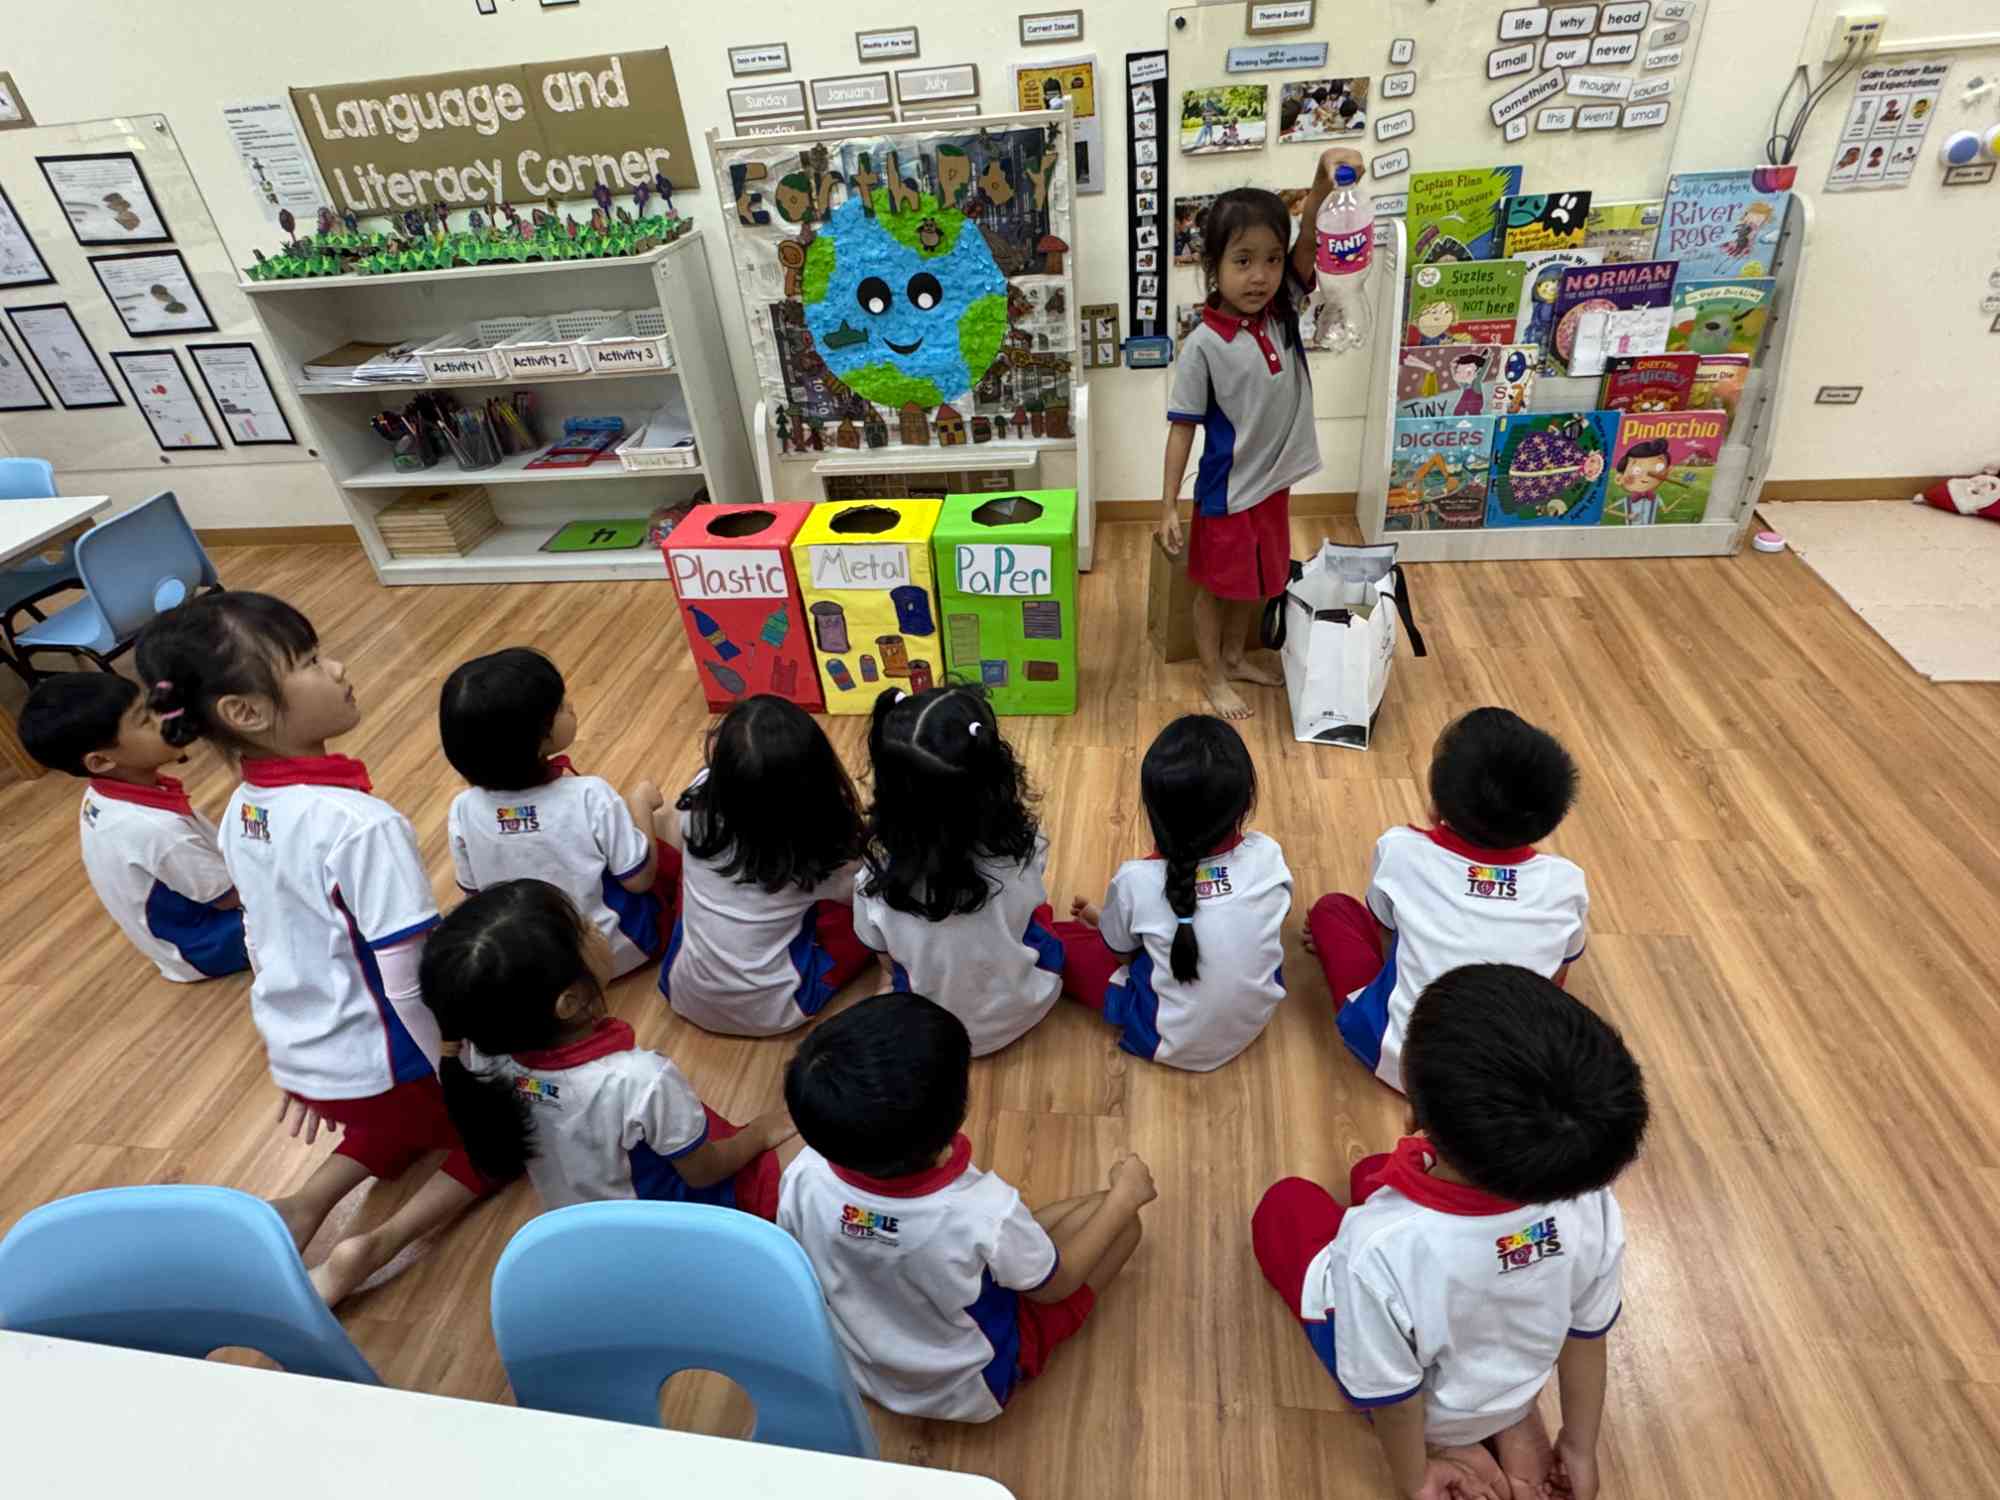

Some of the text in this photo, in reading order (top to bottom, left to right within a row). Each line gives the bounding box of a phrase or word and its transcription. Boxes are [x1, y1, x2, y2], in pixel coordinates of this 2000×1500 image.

[1260, 12, 1281, 20] Theme
[1559, 15, 1586, 30] why
[1607, 11, 1640, 26] head
[1027, 22, 1075, 33] Current Issues
[1514, 18, 1533, 31] life
[1556, 49, 1577, 60] our
[1596, 44, 1633, 57] never
[1496, 53, 1528, 70] small
[1861, 64, 1948, 80] Calm Corner Rules
[925, 77, 949, 91] July
[1390, 79, 1408, 93] big
[1578, 79, 1621, 93] thought
[1633, 80, 1669, 98] sound
[1860, 77, 1940, 92] and Expectations
[308, 82, 527, 144] Language
[541, 56, 629, 114] and
[827, 86, 876, 101] January
[1498, 76, 1558, 118] something
[745, 94, 788, 110] Sunday
[1546, 110, 1566, 124] this
[1583, 110, 1614, 122] went
[1631, 106, 1661, 121] small
[1382, 118, 1407, 134] then
[1379, 157, 1402, 172] very
[334, 156, 503, 211] Literacy
[516, 146, 671, 197] Corner
[1413, 175, 1483, 195] Captain Flinn
[1669, 200, 1743, 227] River
[1669, 224, 1725, 253] Rose
[1452, 269, 1495, 285] Sizzles
[1566, 264, 1672, 291] NORMAN
[1446, 284, 1508, 298] completely
[1463, 300, 1515, 315] NOT here
[513, 353, 569, 368] Activity 2
[599, 348, 654, 363] Activity 3
[433, 359, 483, 375] Activity 1
[1622, 417, 1720, 446] Pinocchio
[1400, 431, 1483, 448] DIGGERS
[815, 546, 906, 584] Metal
[671, 552, 786, 597] Plastic
